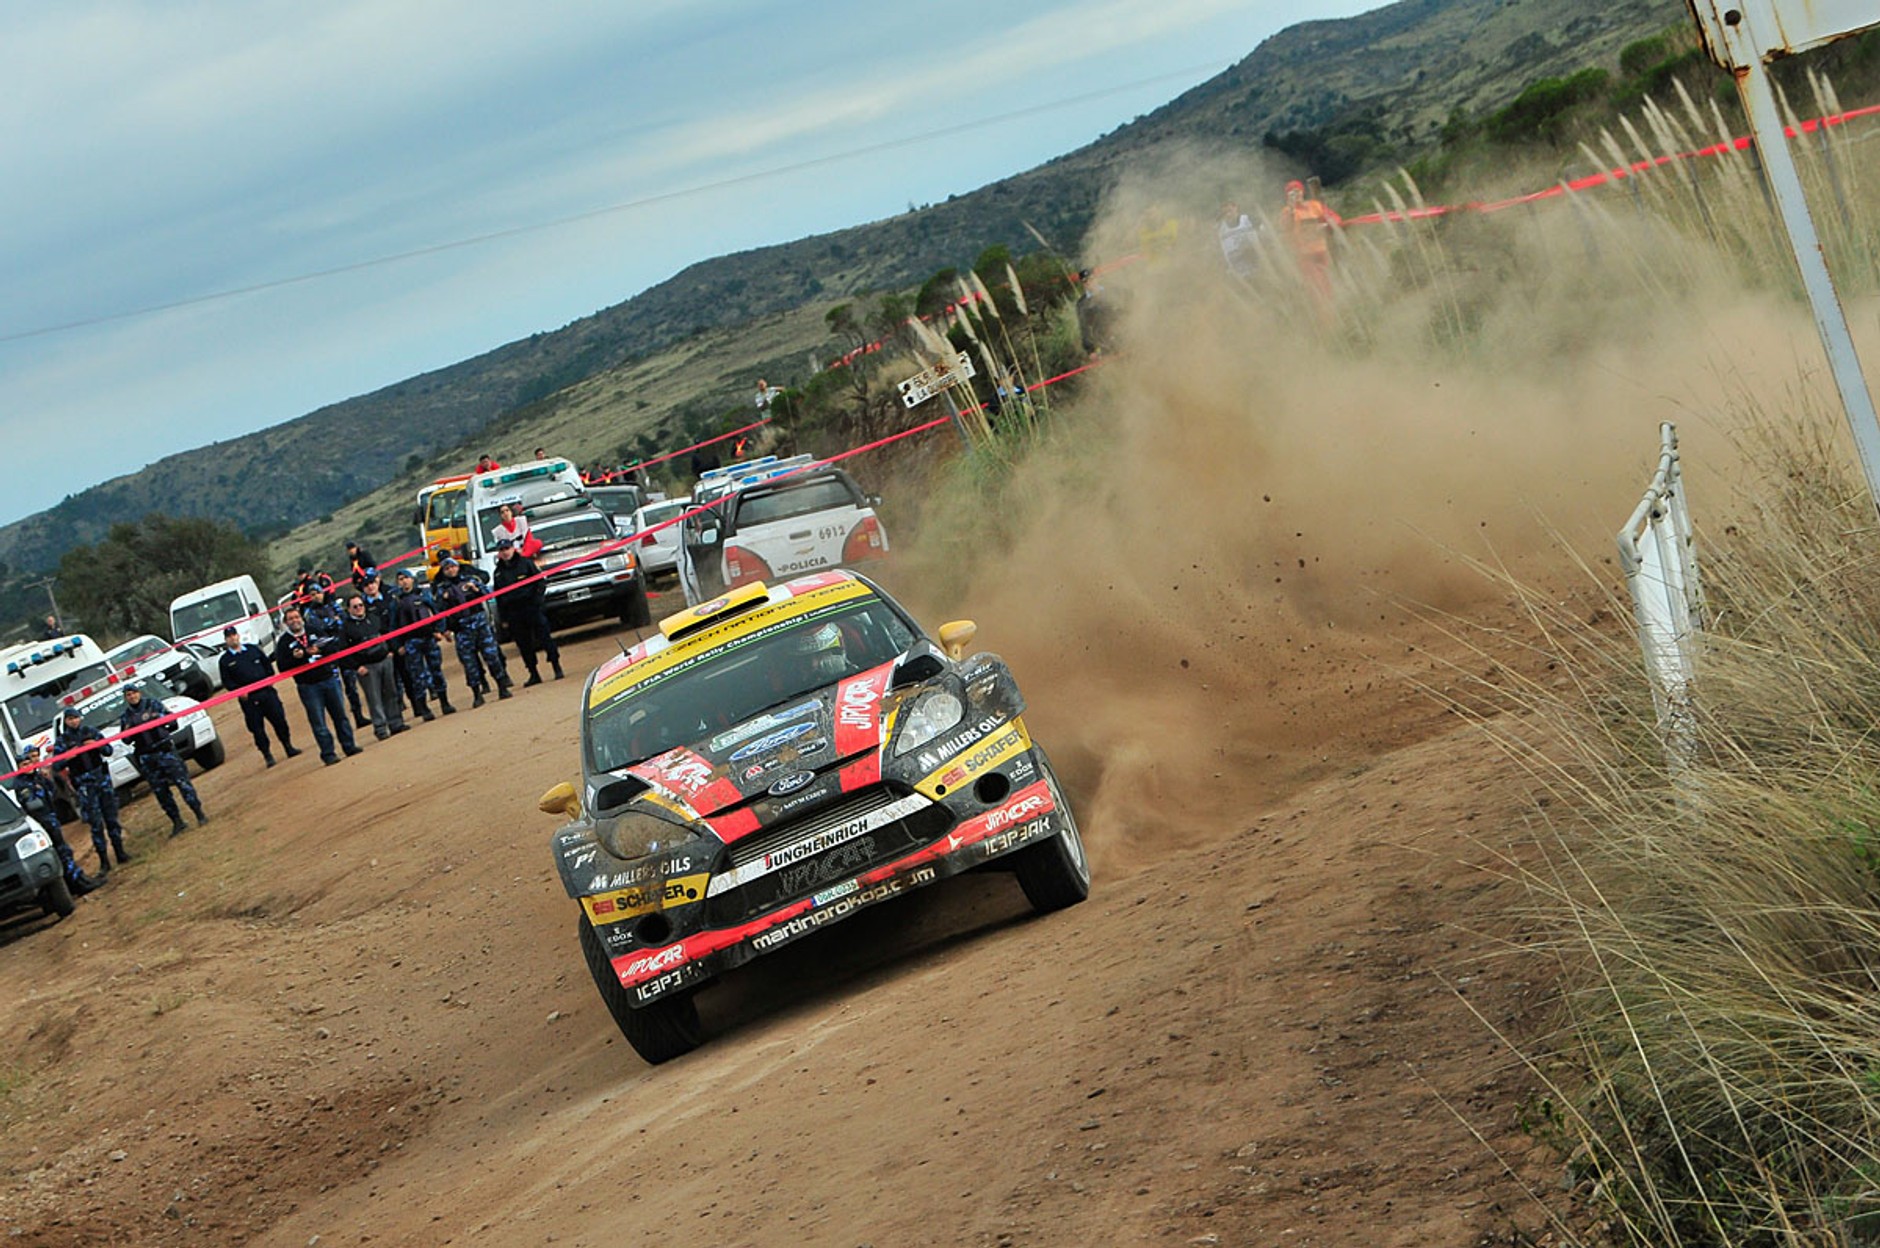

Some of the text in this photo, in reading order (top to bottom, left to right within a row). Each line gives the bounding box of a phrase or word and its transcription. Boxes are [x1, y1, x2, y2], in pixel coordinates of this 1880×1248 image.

[818, 525, 846, 540] 6912
[782, 556, 828, 573] POLICIA
[643, 614, 804, 686] FIA World Rally Championship
[937, 727, 982, 761] MILLERS
[985, 795, 1043, 831] JIPOCAR
[764, 818, 869, 870] JUNGHEINRICH
